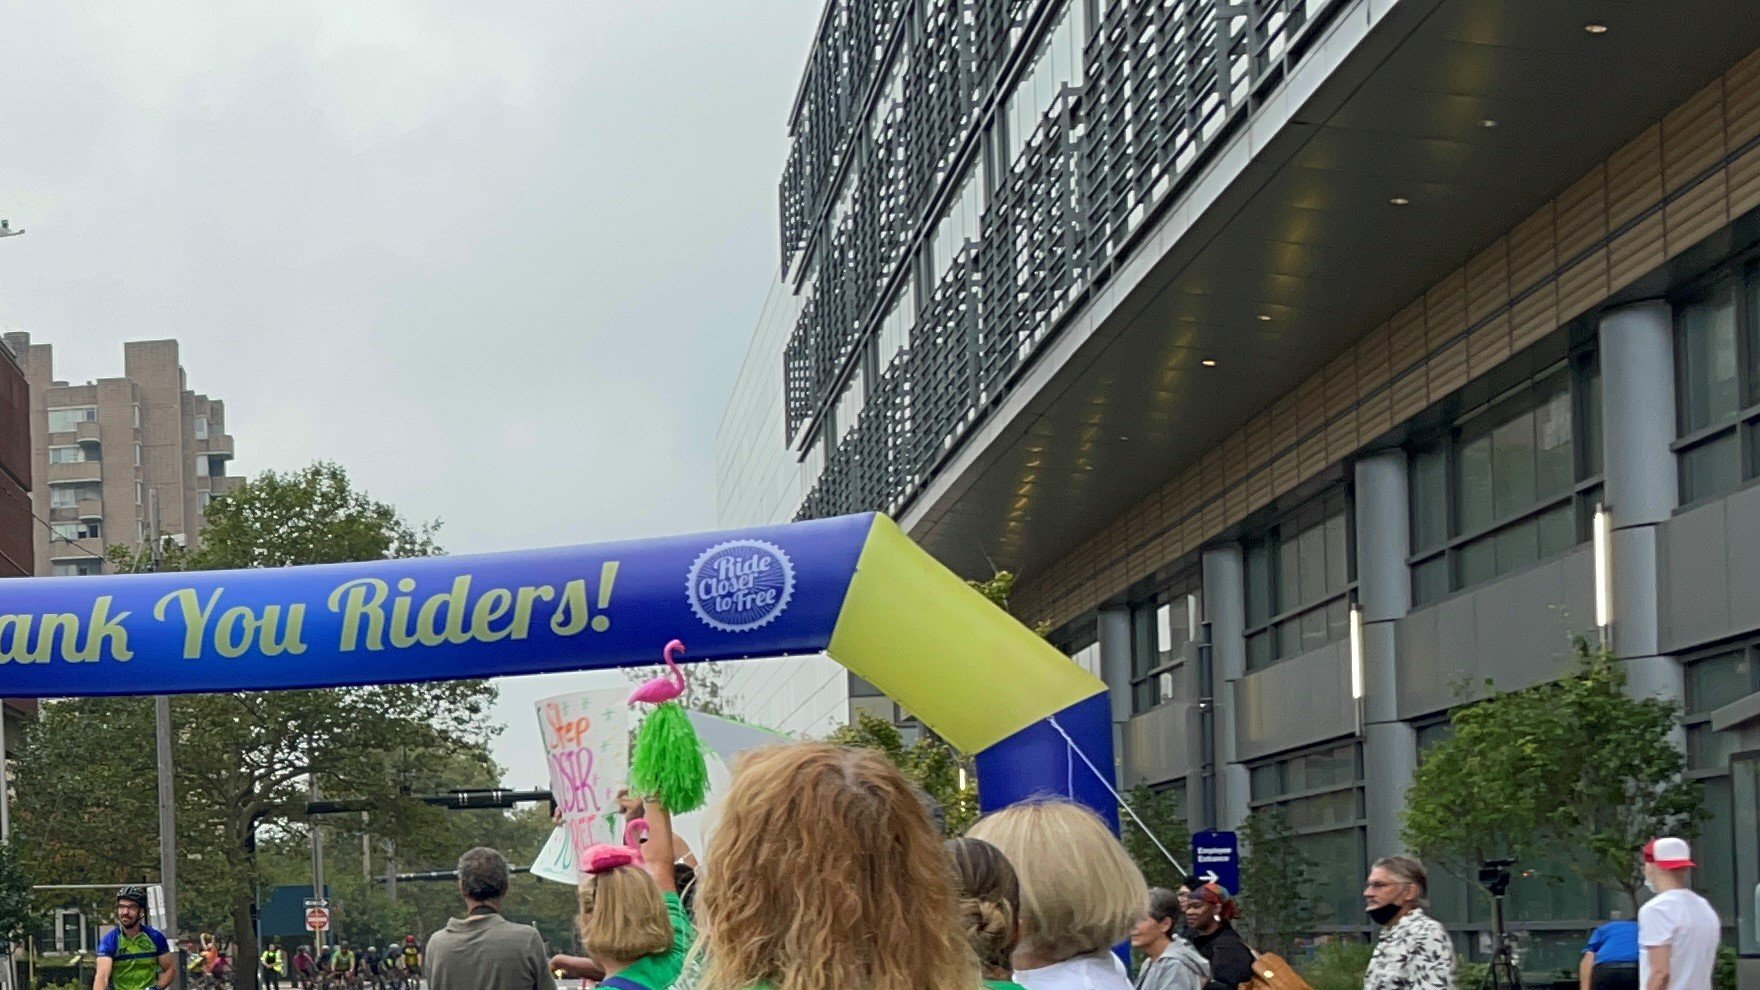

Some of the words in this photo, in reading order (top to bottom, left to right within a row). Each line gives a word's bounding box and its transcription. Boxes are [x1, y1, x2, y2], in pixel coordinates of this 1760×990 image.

[713, 554, 771, 580] Ride
[699, 573, 758, 600] Closer
[153, 586, 308, 660] You
[327, 561, 620, 652] Riders!
[715, 596, 732, 612] to
[732, 589, 776, 611] Free
